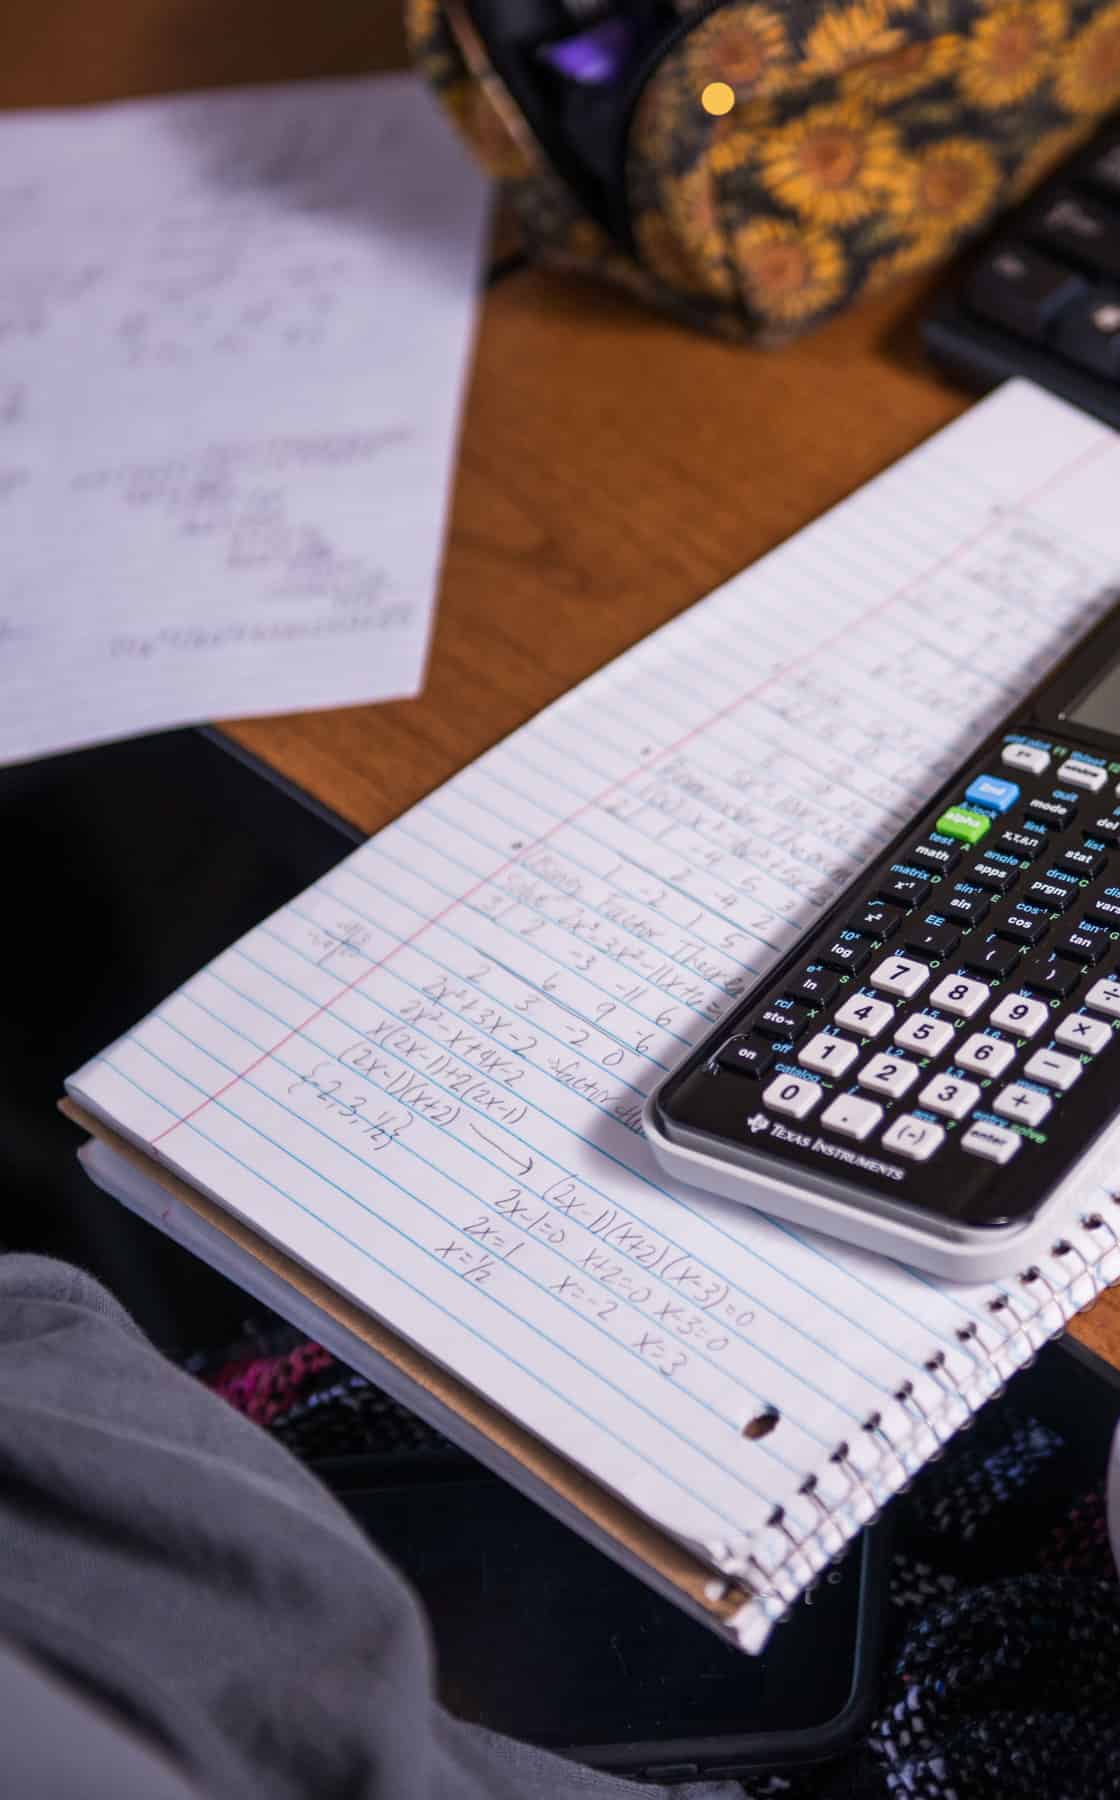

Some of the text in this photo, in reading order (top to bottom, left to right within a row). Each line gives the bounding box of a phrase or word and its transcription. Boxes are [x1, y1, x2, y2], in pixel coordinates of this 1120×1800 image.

[1030, 800, 1067, 815] mode
[1024, 821, 1047, 834] link
[1096, 818, 1120, 831] del
[929, 832, 954, 846] test
[1084, 839, 1105, 852] list
[915, 845, 950, 862] math
[1065, 850, 1093, 864] stat
[889, 863, 930, 881] matrix
[974, 863, 1008, 879] apps
[1046, 868, 1079, 883] draw
[929, 875, 942, 884] D
[1031, 881, 1067, 897] prgm
[950, 899, 972, 911] sin
[990, 894, 1002, 903] E
[924, 914, 946, 927] EE
[1007, 916, 1033, 930] cos
[1049, 912, 1062, 921] F
[1069, 933, 1092, 948] tan
[1109, 931, 1120, 941] G
[831, 943, 854, 958] log
[869, 941, 882, 950] N
[1018, 945, 1031, 954] K
[838, 975, 850, 984] S
[889, 965, 911, 981] 7
[947, 984, 969, 1000] 8
[774, 998, 795, 1010] rcl
[853, 1005, 874, 1020] 4
[1009, 1004, 1029, 1020] 9
[912, 1023, 936, 1041] 5
[738, 1048, 757, 1060] on
[772, 1041, 793, 1053] off
[822, 1044, 837, 1060] 1
[974, 1045, 994, 1060] 6
[774, 1062, 821, 1083] catalog
[875, 1064, 898, 1081] 2
[779, 1084, 800, 1100] 0
[937, 1085, 958, 1101] 3
